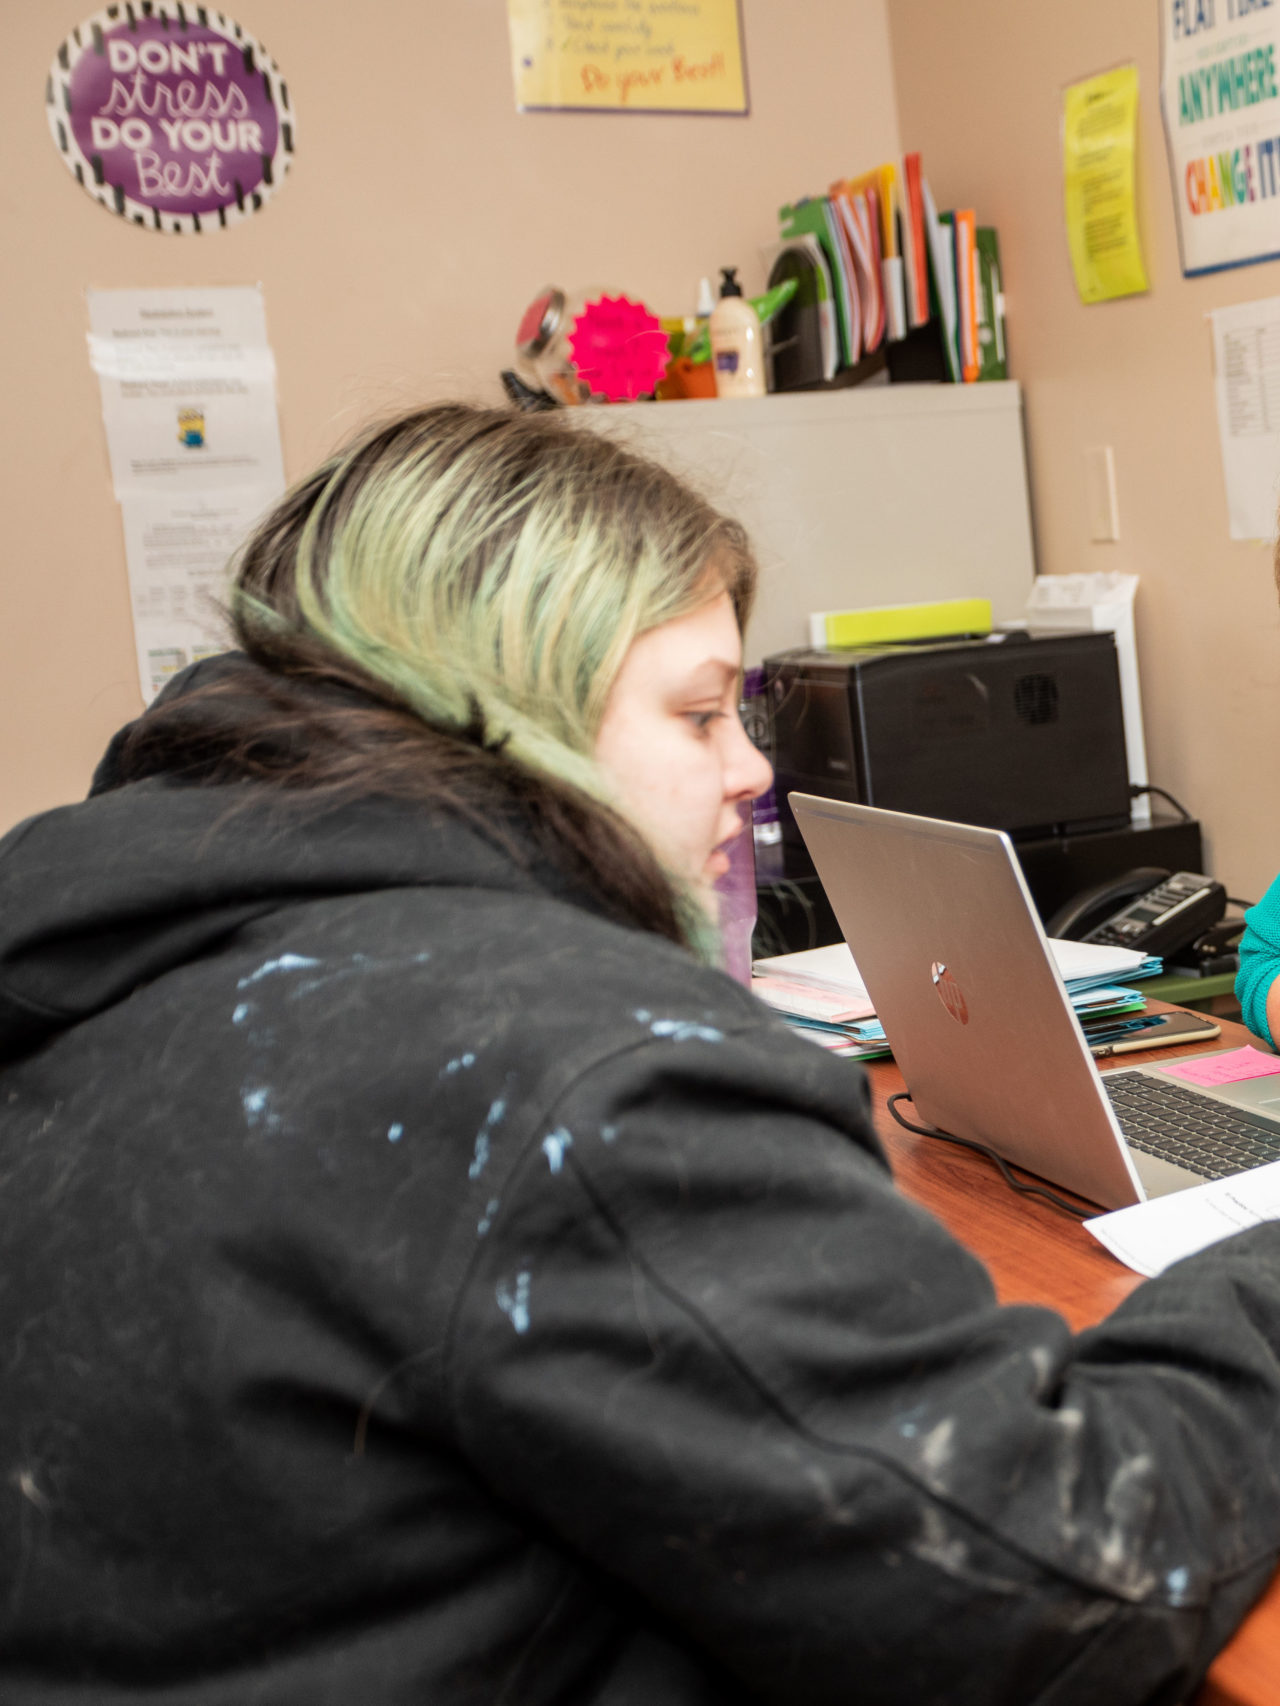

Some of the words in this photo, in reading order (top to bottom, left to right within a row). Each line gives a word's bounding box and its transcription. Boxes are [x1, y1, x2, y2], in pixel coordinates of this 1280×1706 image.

[108, 40, 227, 75] DON'T
[100, 69, 249, 118] stress
[616, 66, 665, 106] your
[1178, 43, 1278, 126] ANYWHERE
[91, 118, 151, 149] DO
[159, 119, 263, 153] YOUR
[134, 150, 231, 198] Best
[1185, 144, 1255, 216] CHANGE
